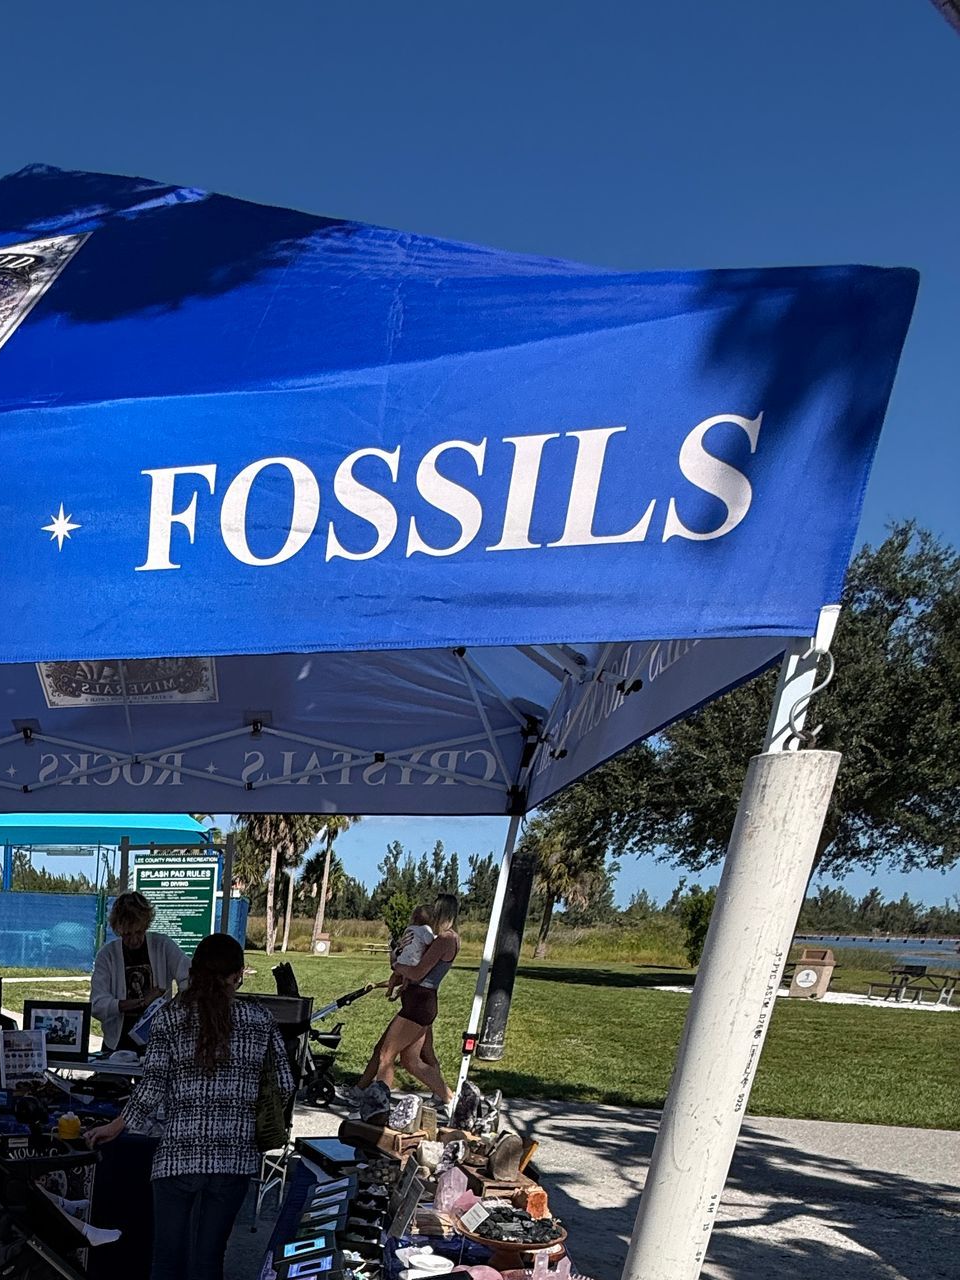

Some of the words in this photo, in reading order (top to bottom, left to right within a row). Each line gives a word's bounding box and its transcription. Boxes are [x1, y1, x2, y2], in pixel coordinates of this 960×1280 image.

[134, 413, 762, 571] FOSSILS
[140, 870, 169, 878] SPLASH
[769, 963, 780, 980] PVC
[762, 985, 774, 1009] ASTM
